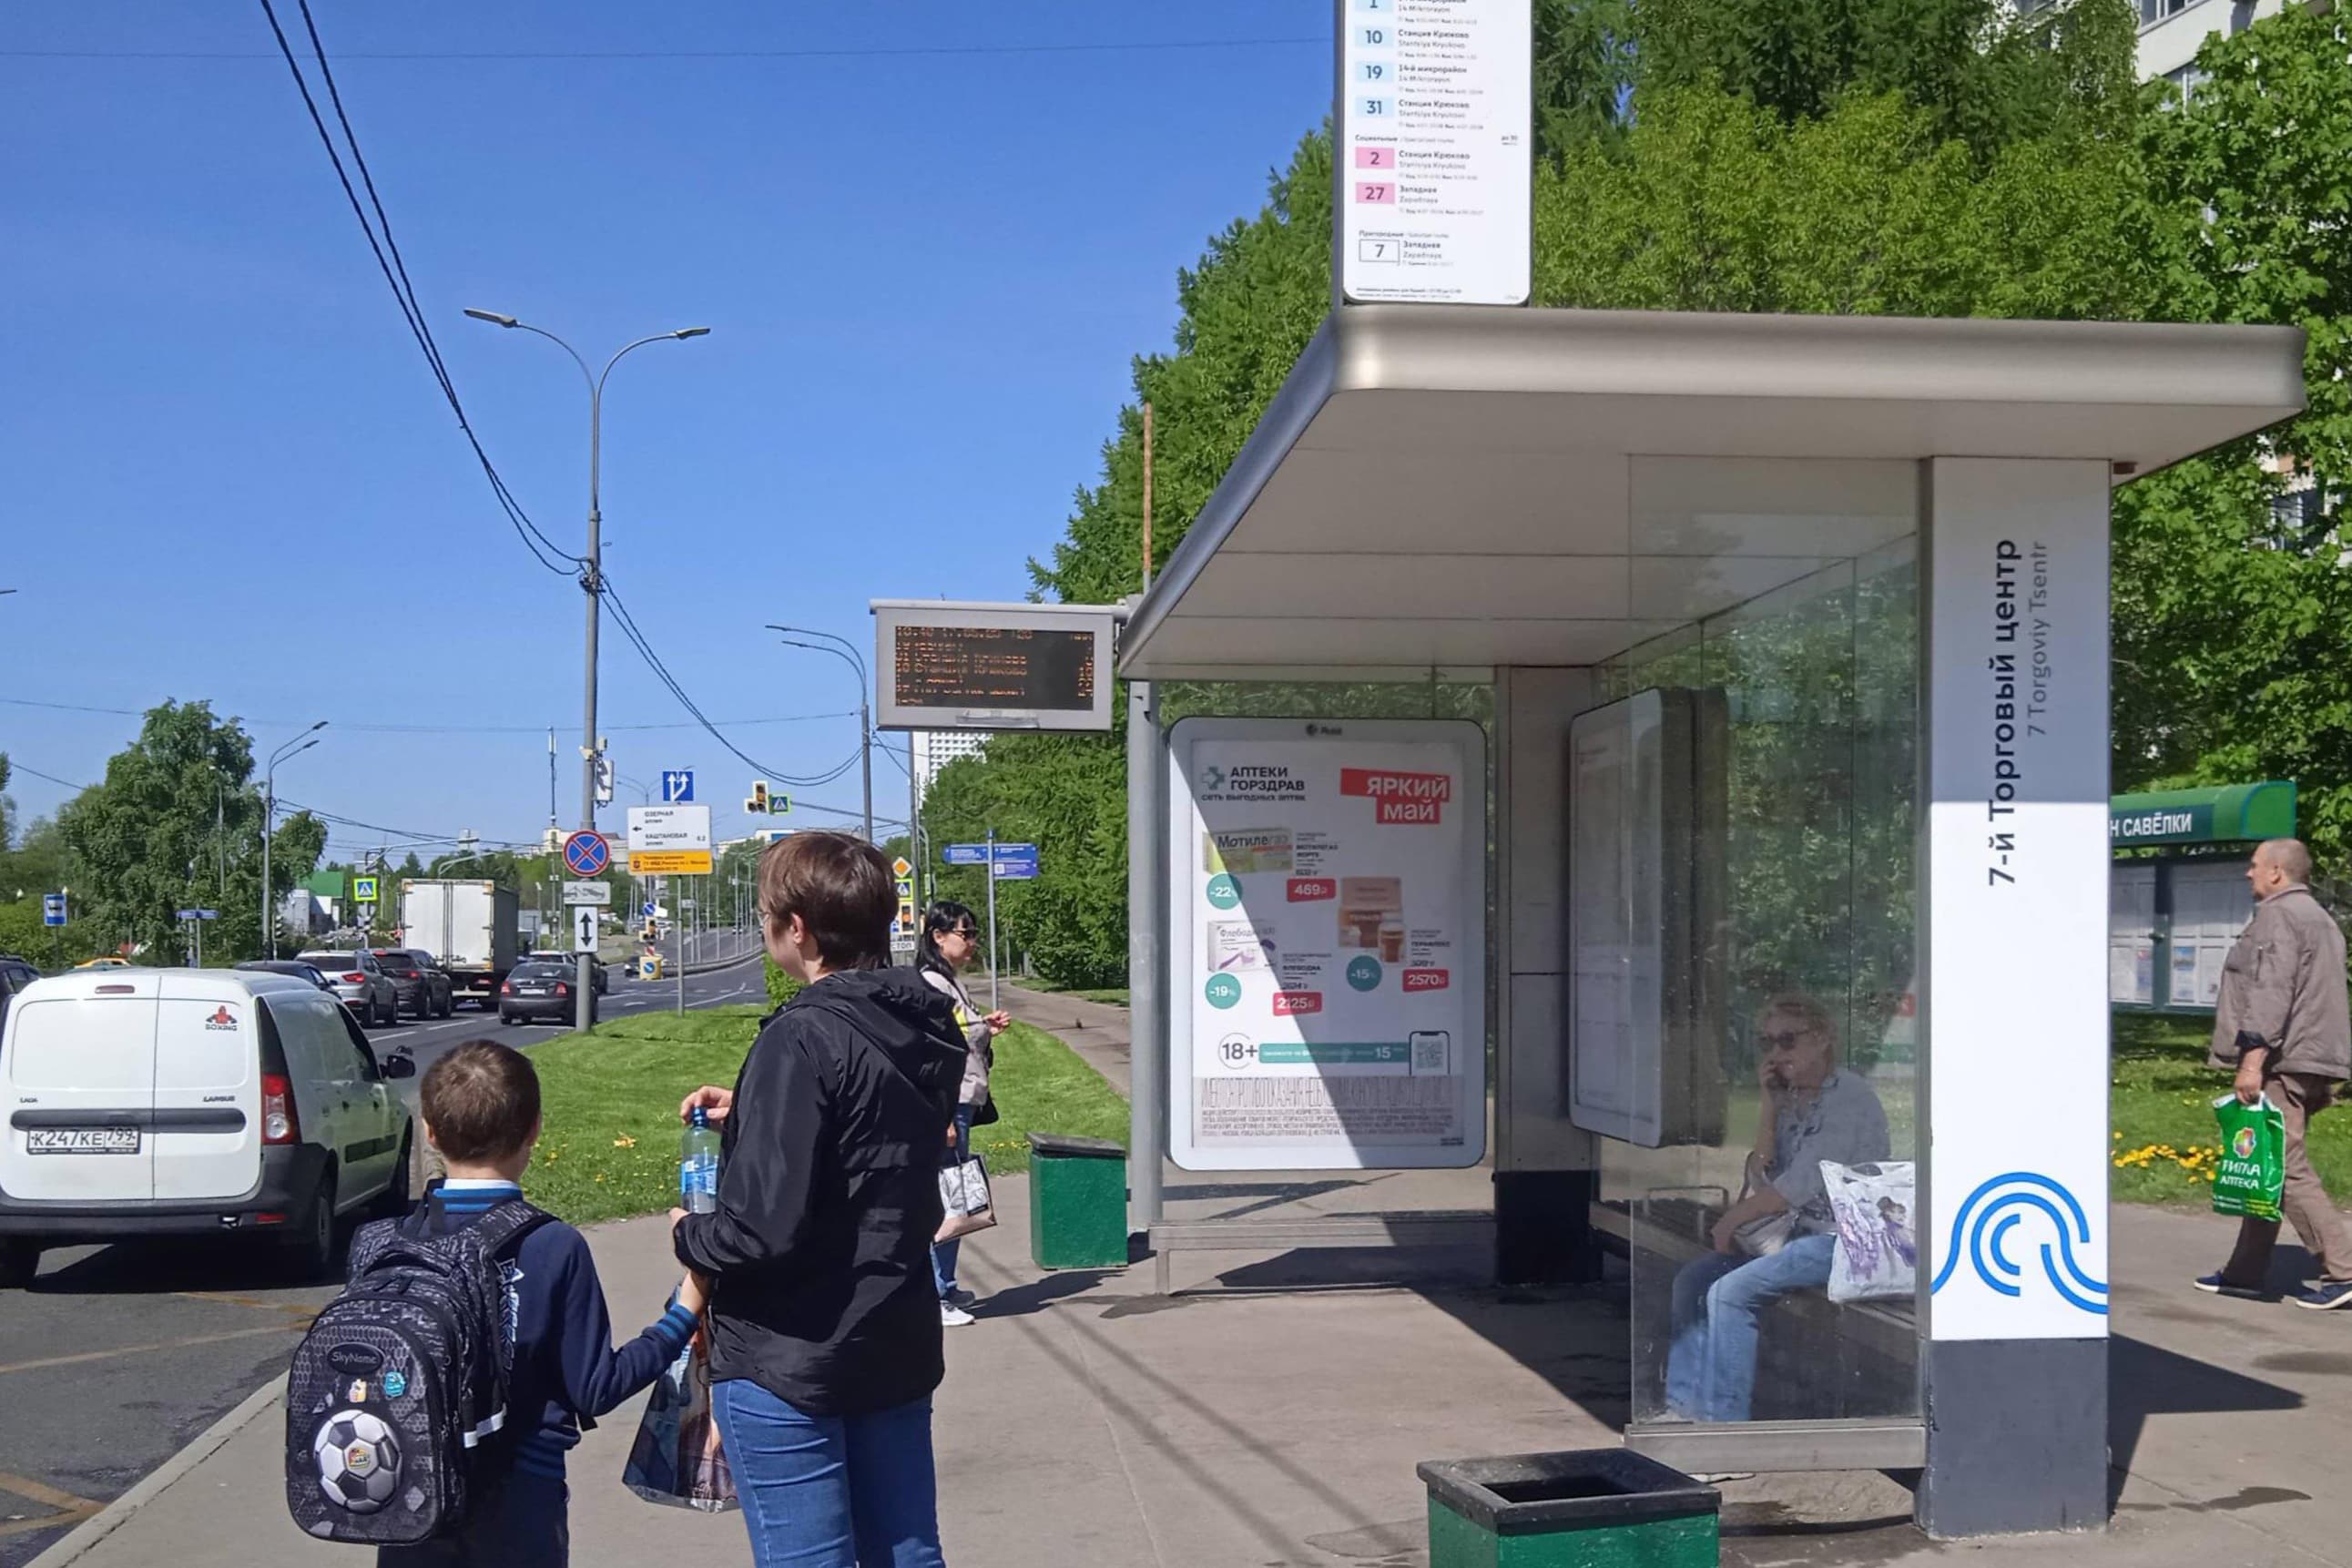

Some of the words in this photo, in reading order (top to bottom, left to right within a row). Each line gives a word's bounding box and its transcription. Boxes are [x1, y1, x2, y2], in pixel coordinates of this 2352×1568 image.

[1366, 30, 1383, 44] 10
[1366, 65, 1383, 79] 19
[1366, 100, 1382, 115] 31
[1370, 151, 1380, 166] 2
[1365, 187, 1385, 200] 27
[1375, 244, 1385, 259] 7
[2028, 542, 2047, 616] Tsentr
[1994, 539, 2021, 643] центр
[2028, 621, 2052, 717] Torgoviy
[1989, 655, 2021, 821] Торговый
[2028, 725, 2046, 737] 7
[1230, 766, 1288, 778] АПТЕКИ
[1230, 780, 1305, 792] ГОРЗДРАВ
[1367, 775, 1450, 799] ЯРКИЙ
[1227, 794, 1275, 802] выгодных
[2123, 812, 2193, 837] САВЁЛКИ
[1989, 832, 2016, 887] 7-й
[1222, 1043, 1258, 1060] 18+
[1376, 1045, 1391, 1059] 15
[107, 1127, 133, 1142] 799
[2220, 1175, 2259, 1189] АПТЕКА
[331, 1351, 377, 1364] SkyName
